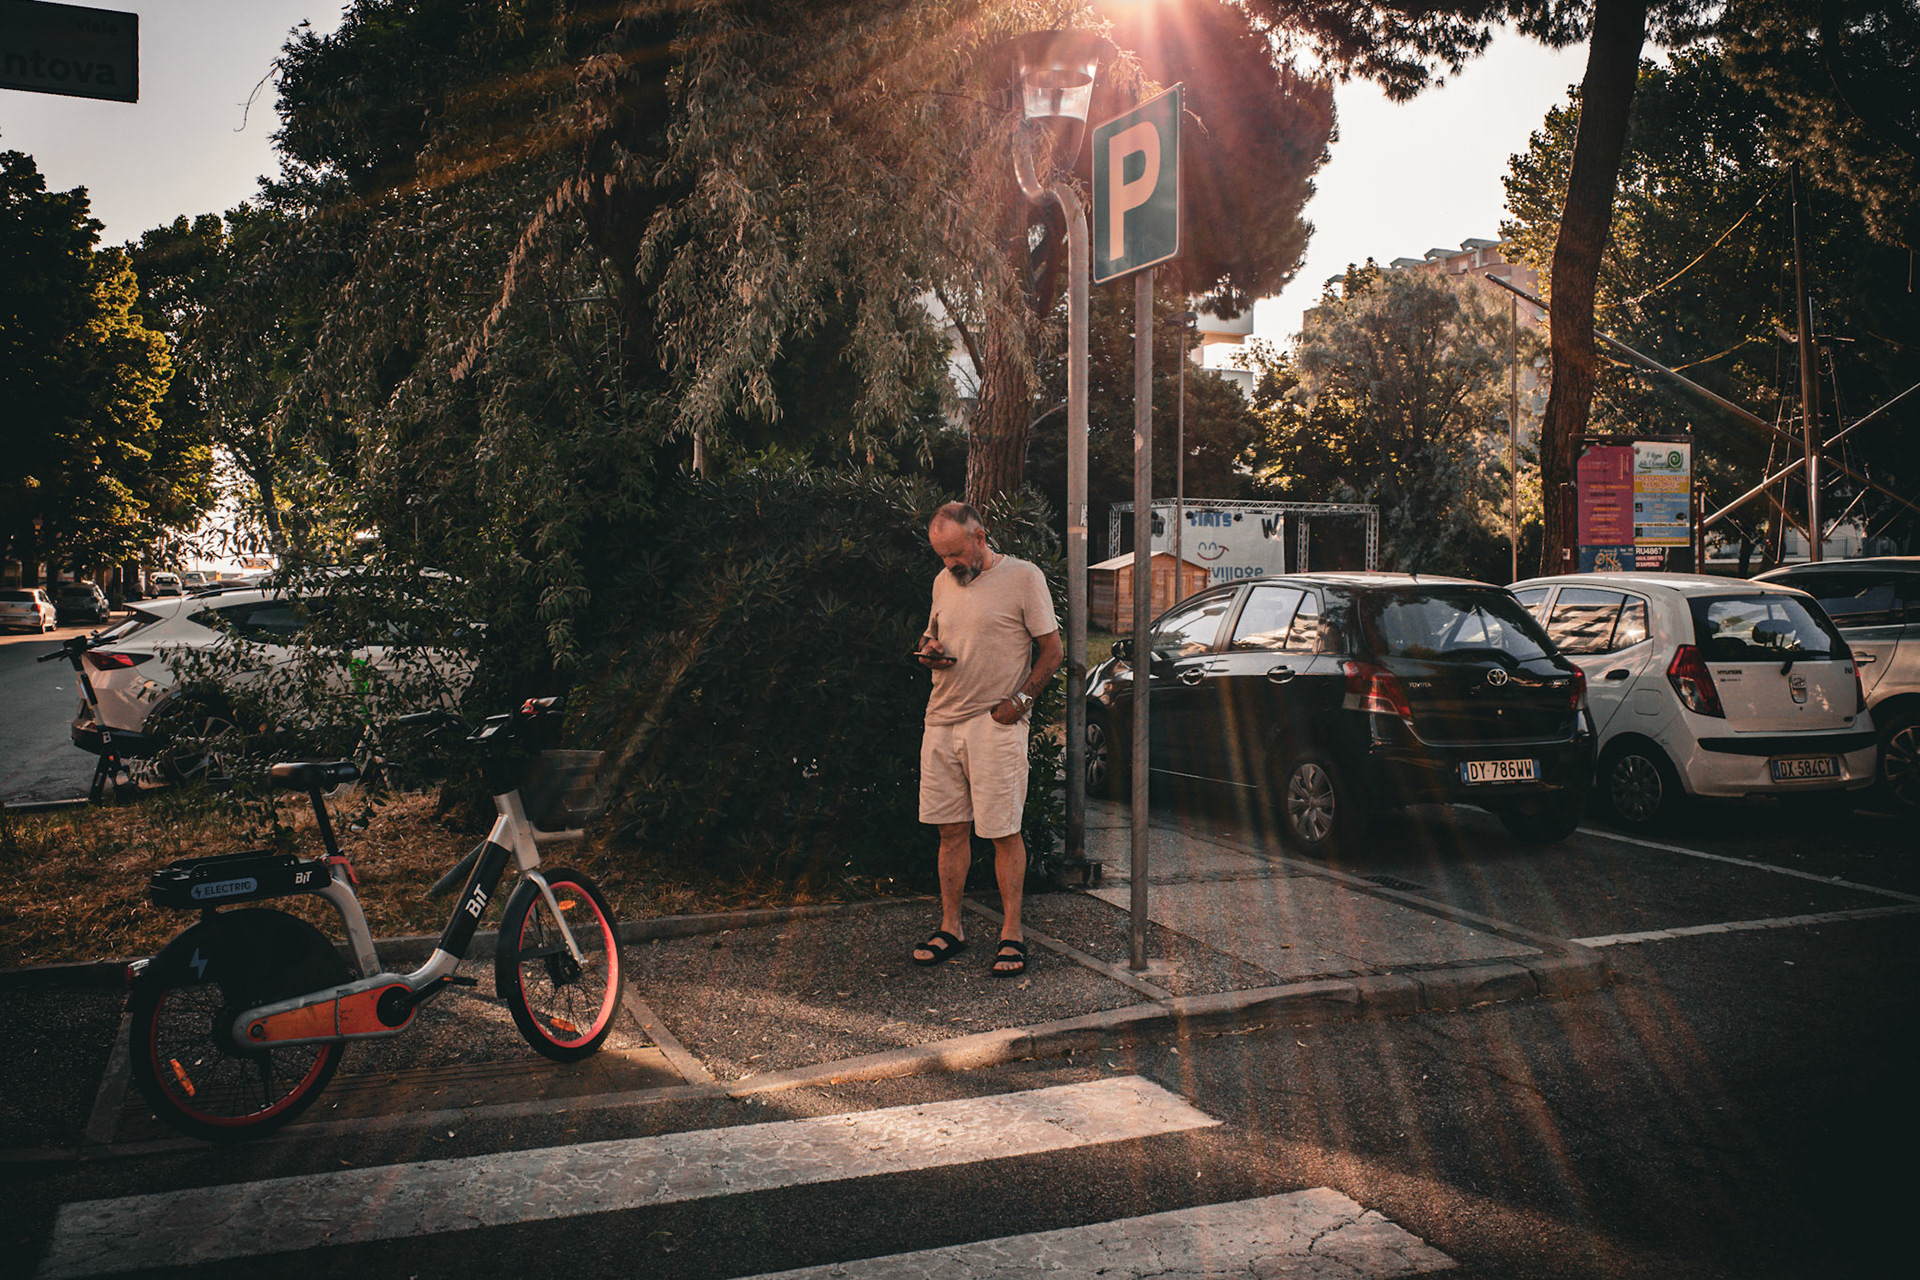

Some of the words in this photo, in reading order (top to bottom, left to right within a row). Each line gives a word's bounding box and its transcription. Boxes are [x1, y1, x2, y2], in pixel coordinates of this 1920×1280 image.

[1, 47, 117, 86] ntova
[1109, 121, 1160, 261] P
[1470, 762, 1485, 780] DY
[1491, 761, 1532, 779] 786WW
